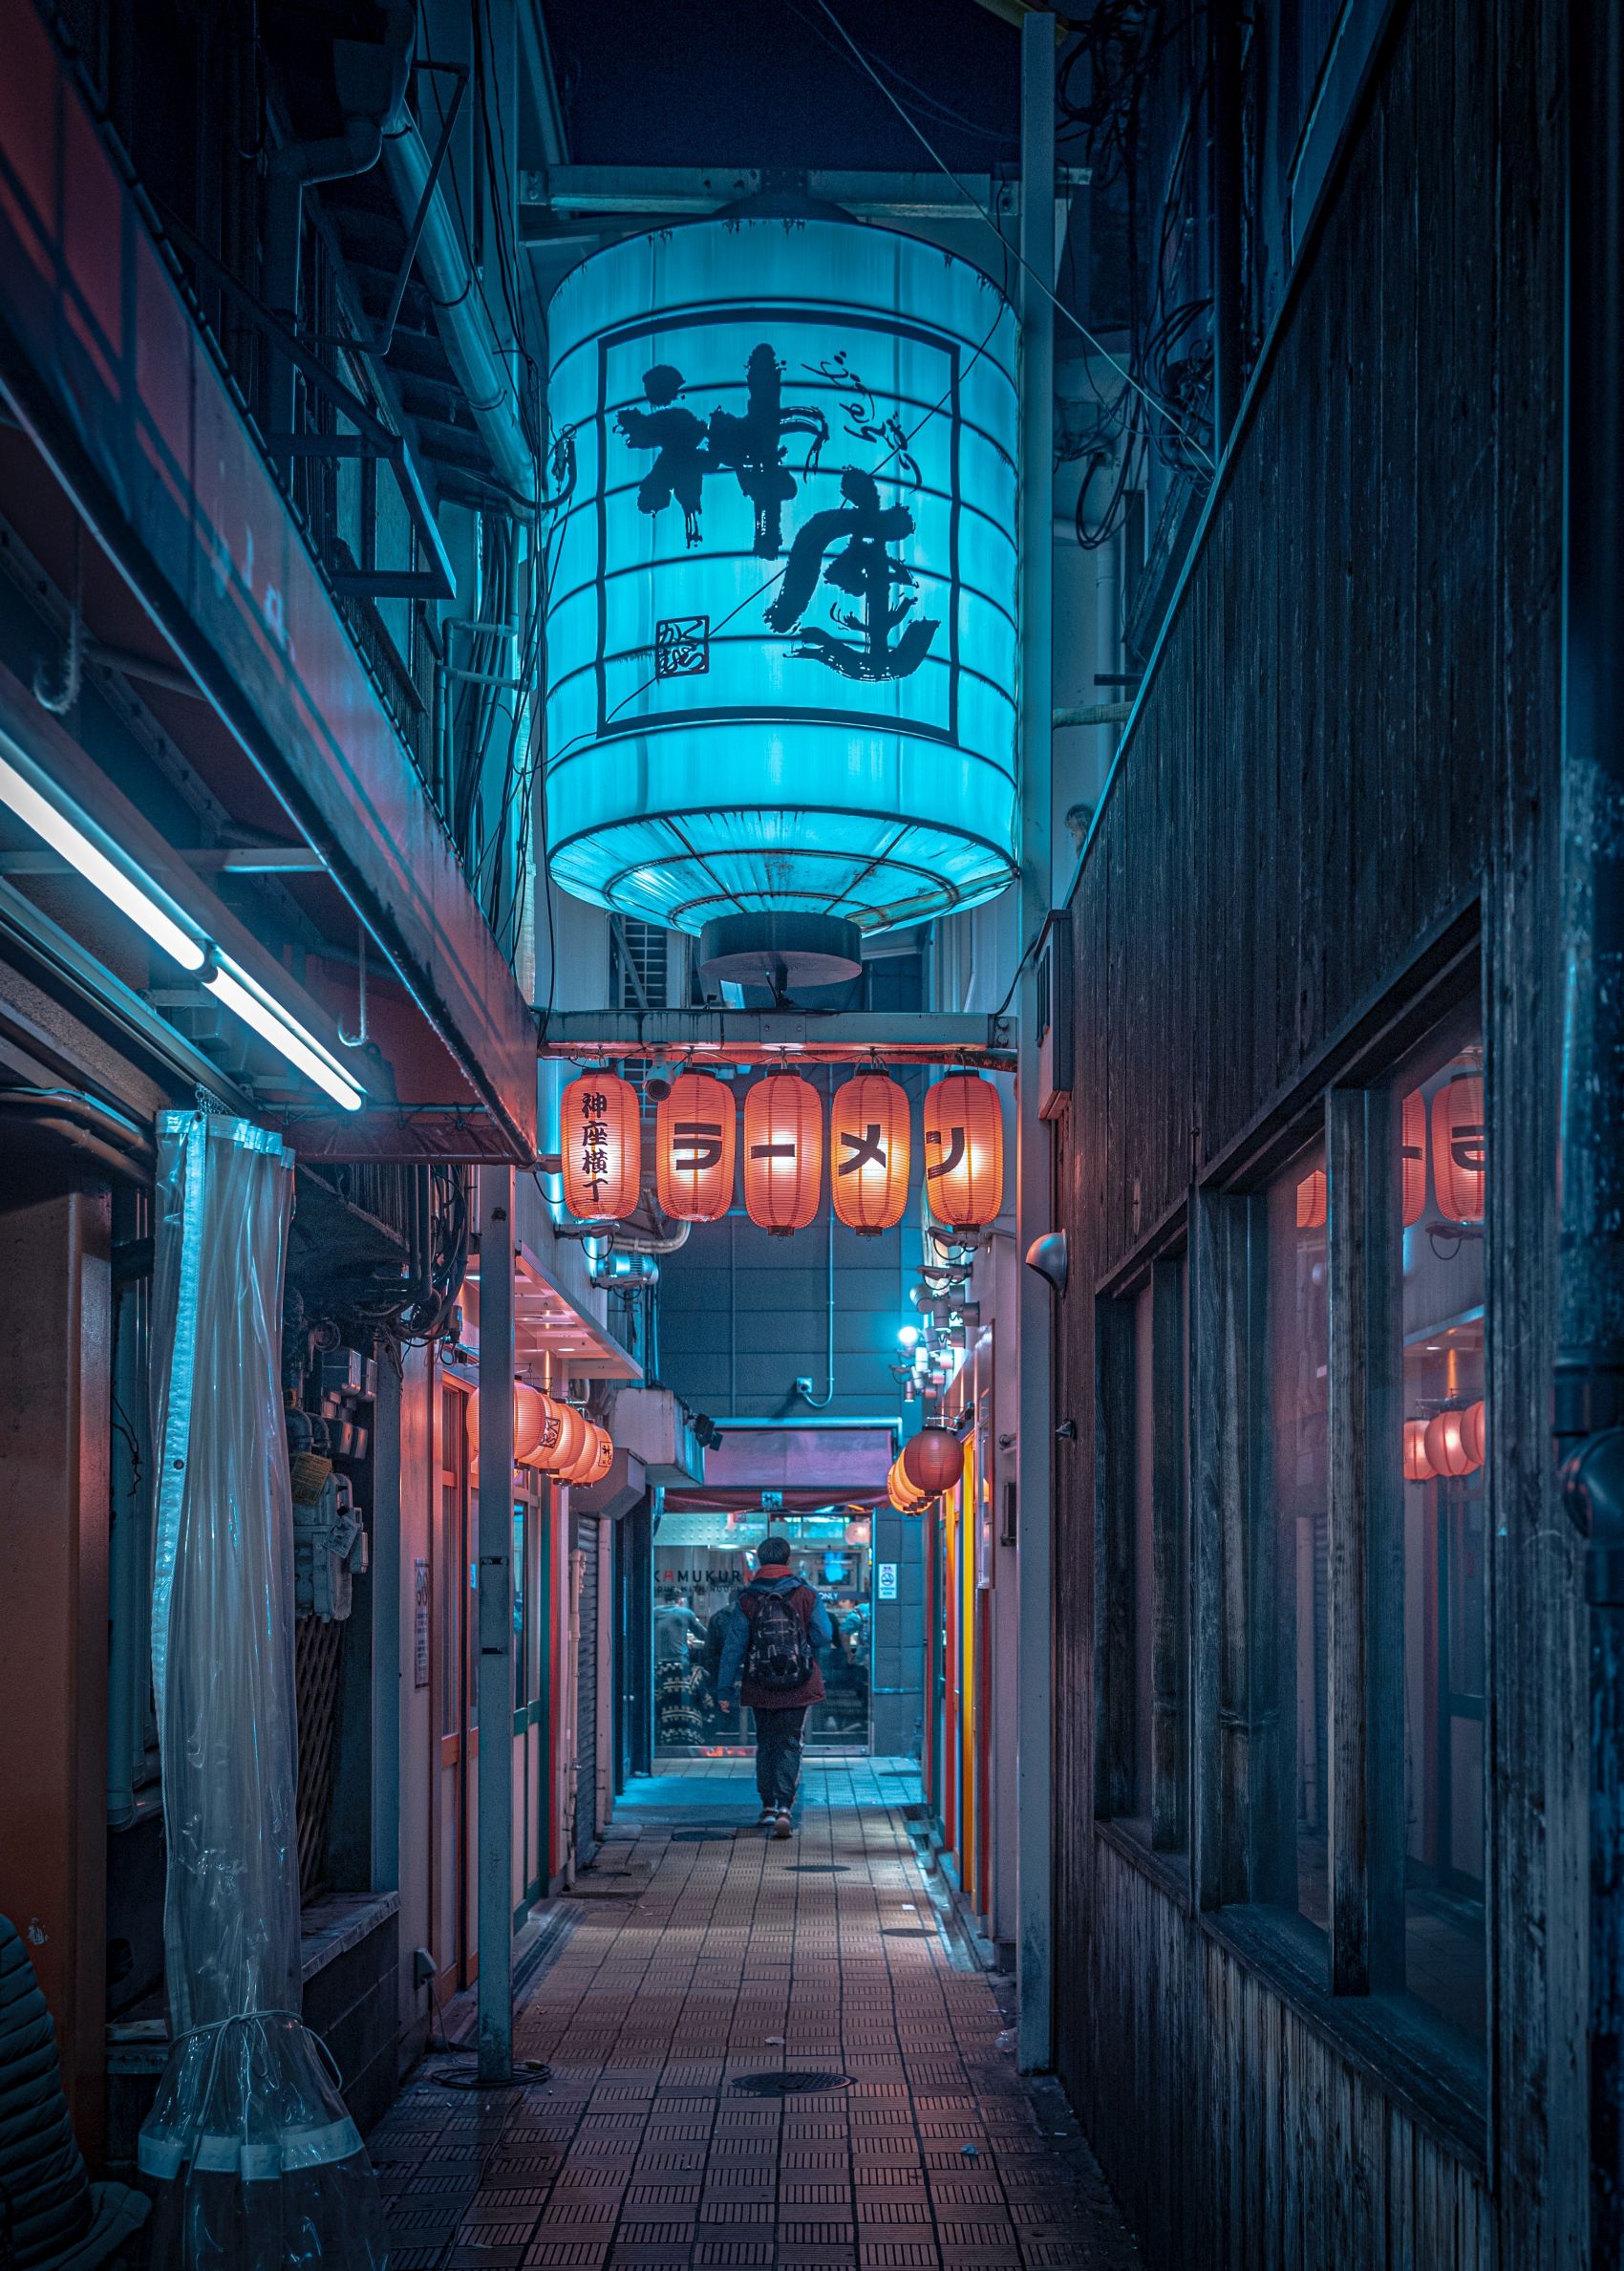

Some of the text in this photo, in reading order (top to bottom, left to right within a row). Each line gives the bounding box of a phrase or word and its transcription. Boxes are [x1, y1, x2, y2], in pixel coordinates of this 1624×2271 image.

[581, 1092, 609, 1203] 神座横丁
[654, 1570, 741, 1583] KAMUKUR
